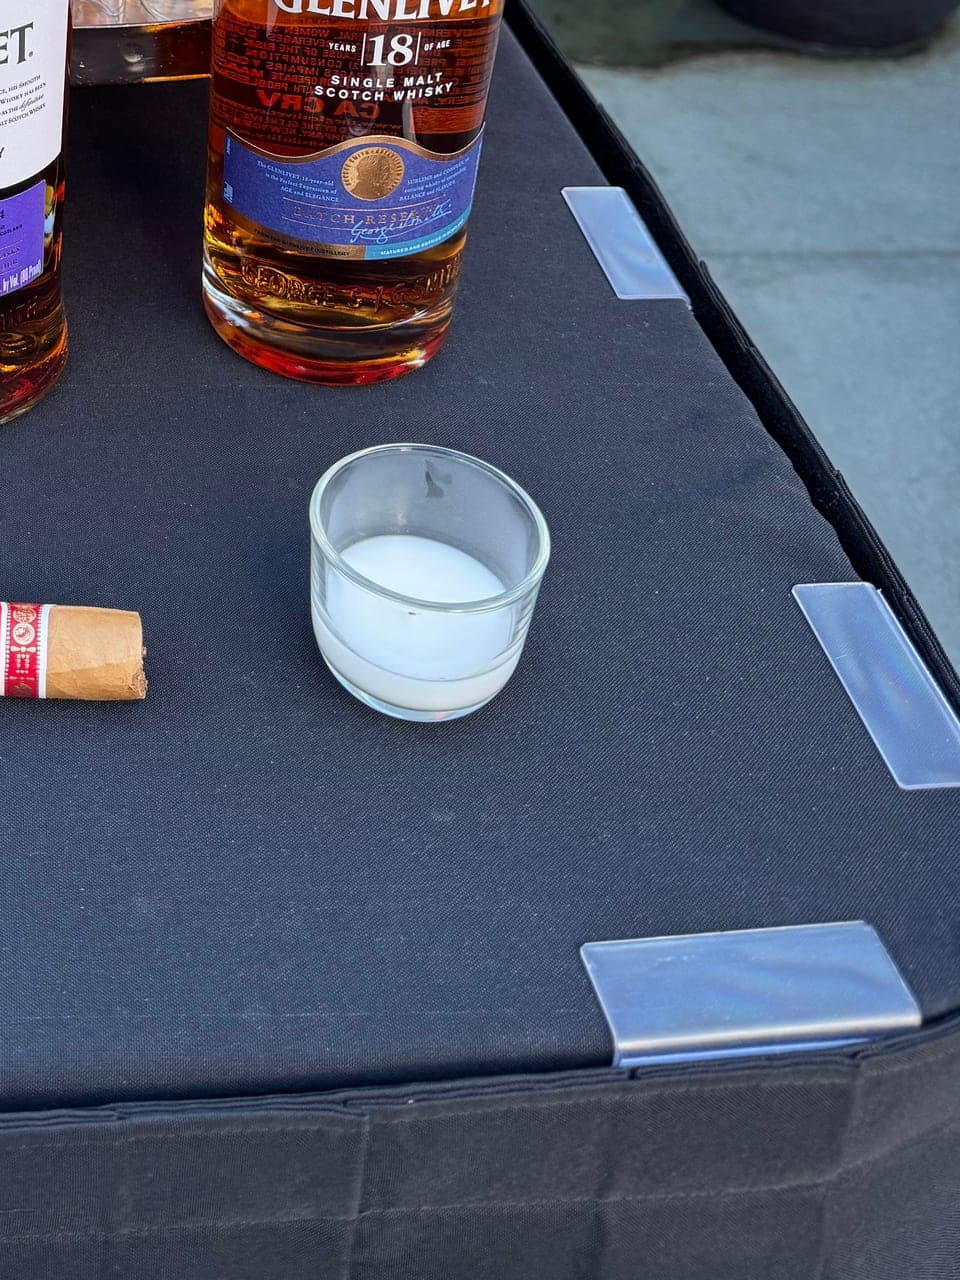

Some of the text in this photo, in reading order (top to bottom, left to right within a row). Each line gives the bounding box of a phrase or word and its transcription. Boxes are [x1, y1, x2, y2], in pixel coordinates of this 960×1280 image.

[328, 42, 357, 53] YEARS
[366, 33, 414, 67] 18
[424, 42, 436, 52] OF
[436, 39, 451, 49] AGE
[330, 75, 395, 89] SINGLE
[403, 72, 443, 88] MALT
[313, 85, 384, 102] SCOTCH
[393, 81, 454, 102] WHISKY
[267, 164, 300, 180] GLENLIVET
[293, 206, 355, 224] BATCH
